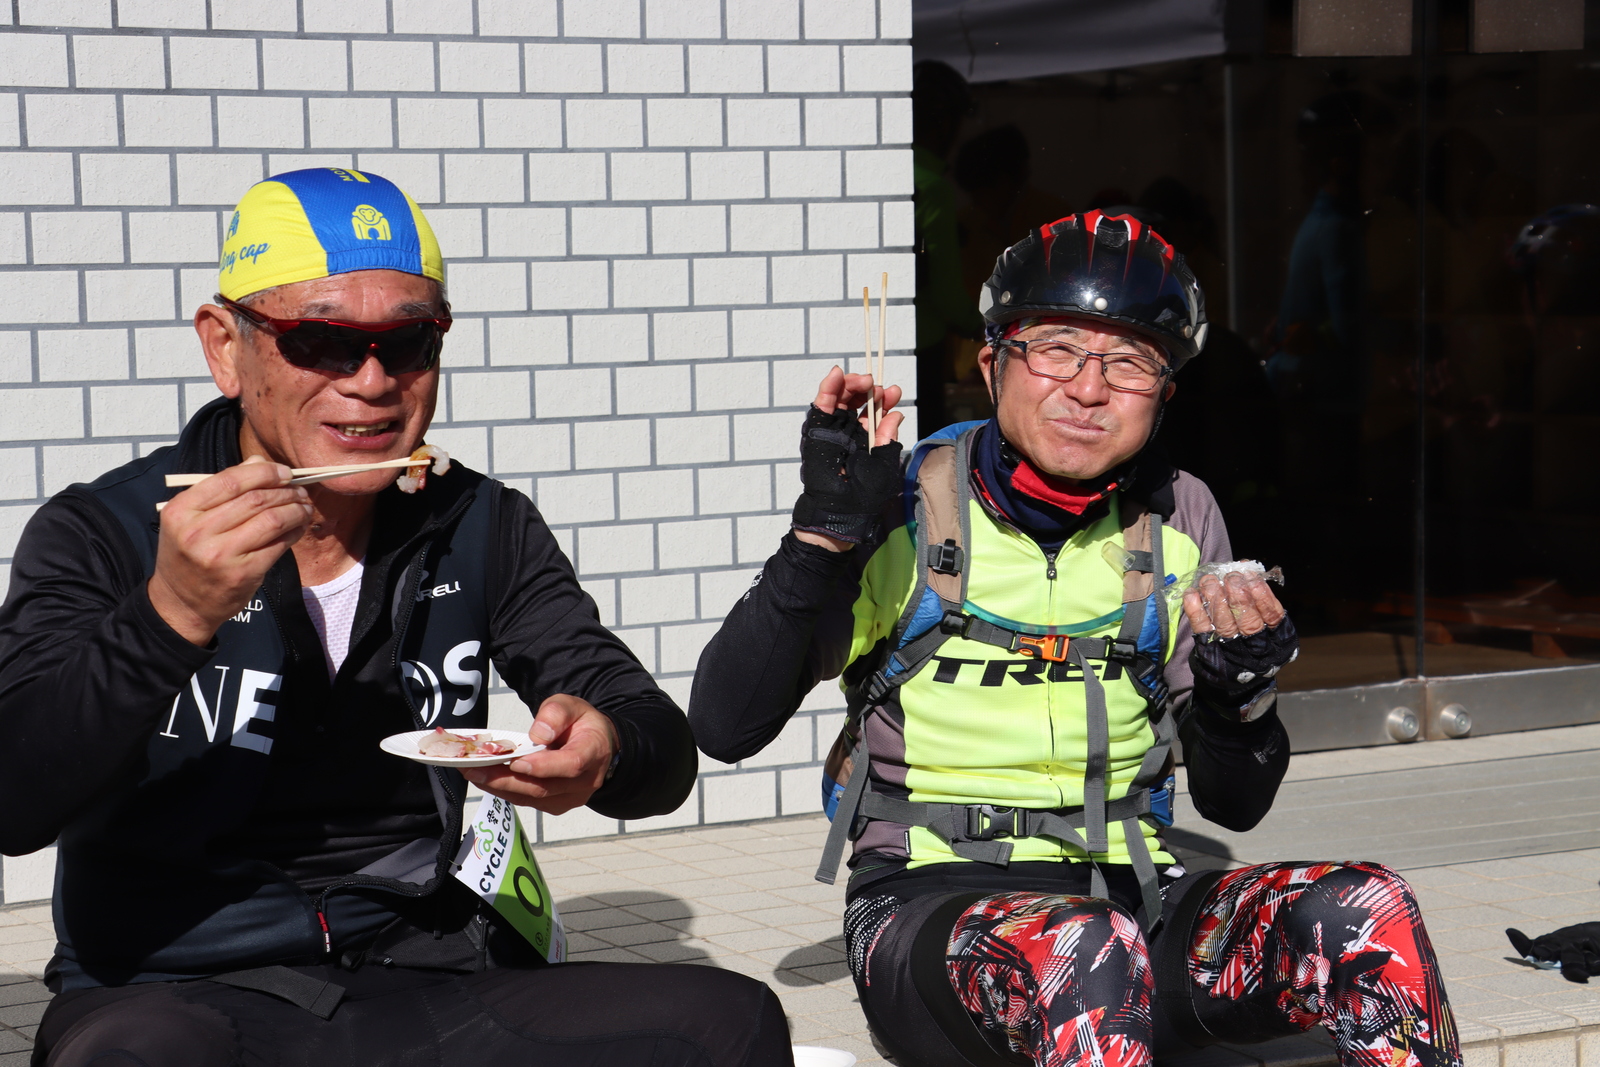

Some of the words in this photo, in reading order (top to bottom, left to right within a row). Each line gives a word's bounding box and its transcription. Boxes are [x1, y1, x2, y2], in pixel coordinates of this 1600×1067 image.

[239, 243, 271, 265] cap
[244, 599, 264, 612] LD
[479, 831, 508, 893] CYCLE
